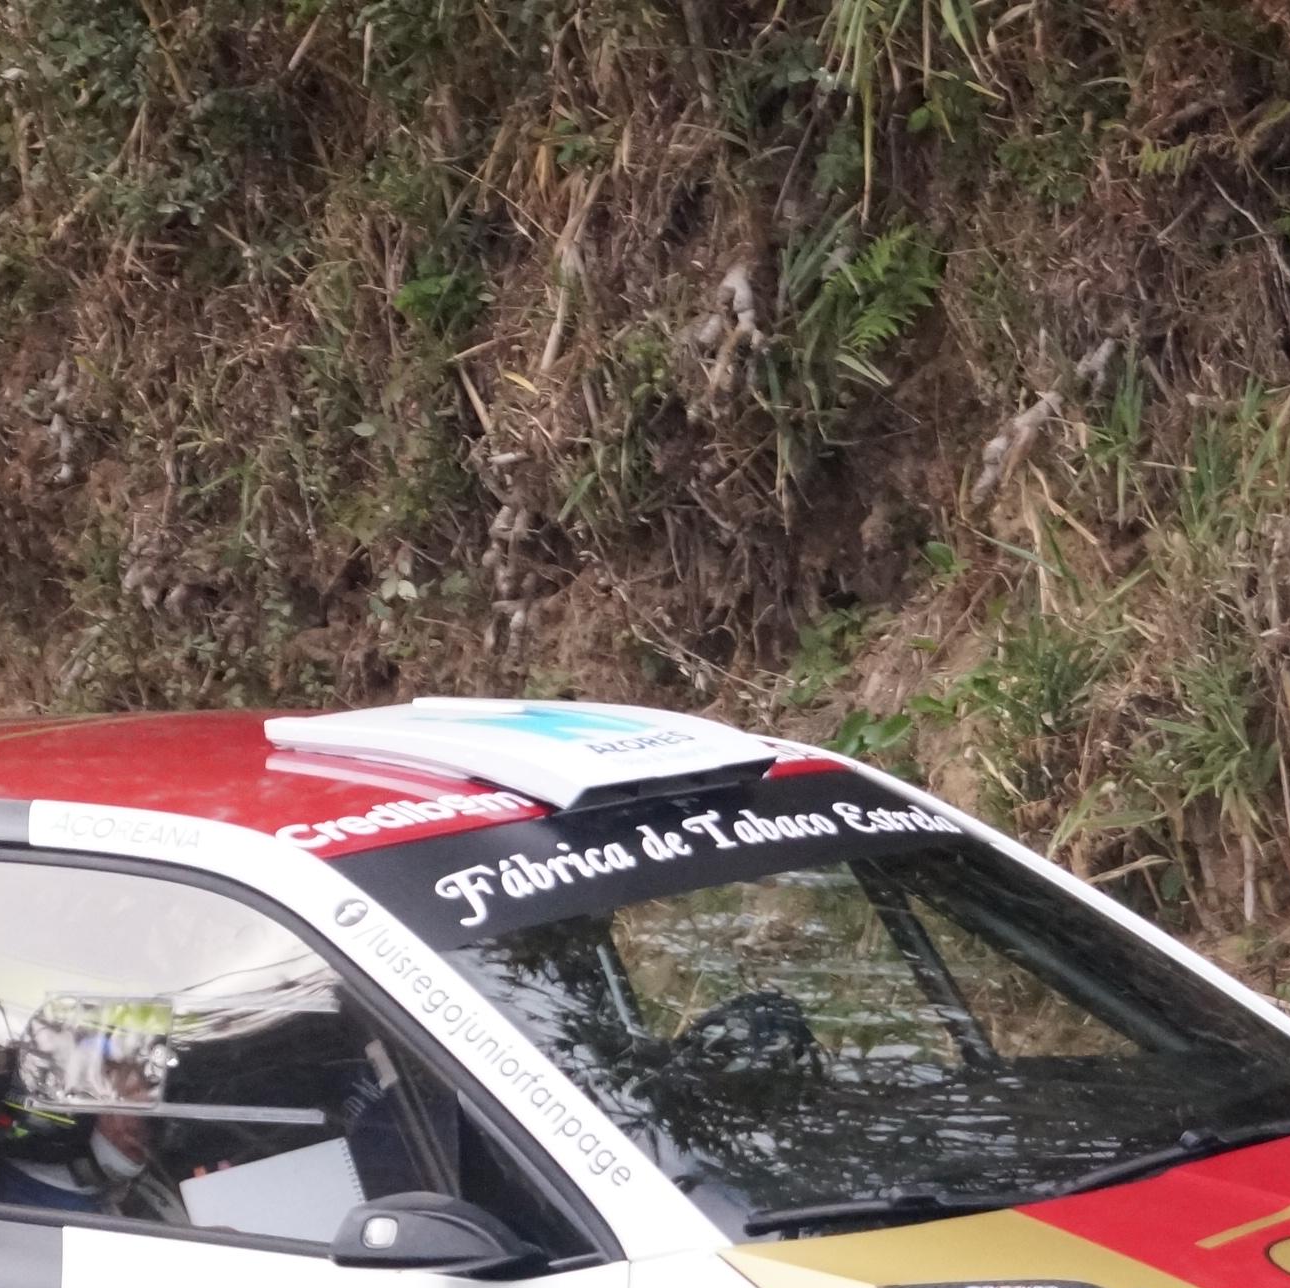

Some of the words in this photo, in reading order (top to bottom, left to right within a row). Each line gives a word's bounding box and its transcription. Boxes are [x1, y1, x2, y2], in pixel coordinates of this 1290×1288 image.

[586, 731, 695, 754] AZORES
[434, 842, 637, 927] Fábrica
[636, 825, 692, 861] de
[681, 809, 839, 850] Tabaco
[832, 802, 963, 834] Estrela
